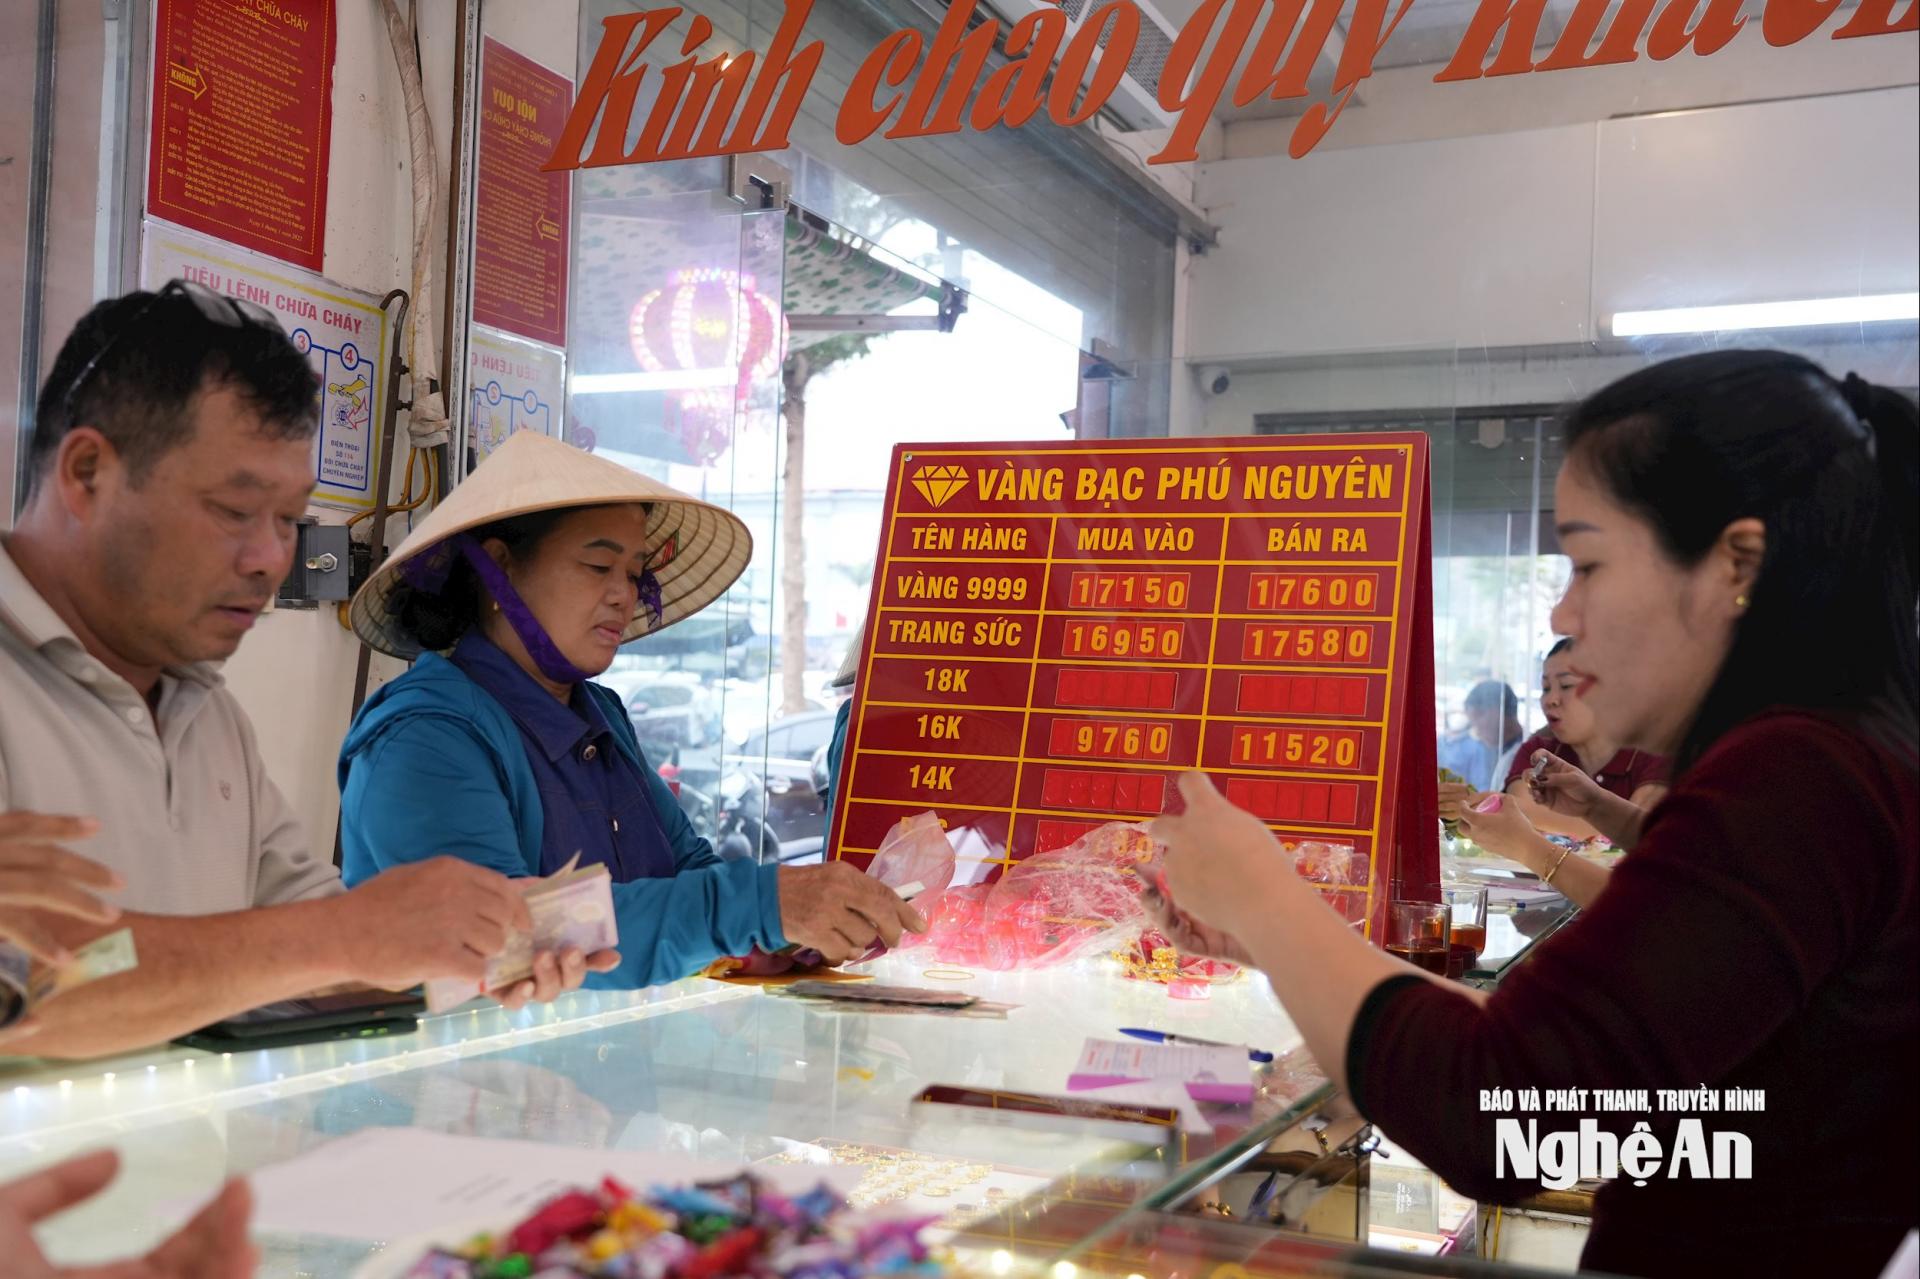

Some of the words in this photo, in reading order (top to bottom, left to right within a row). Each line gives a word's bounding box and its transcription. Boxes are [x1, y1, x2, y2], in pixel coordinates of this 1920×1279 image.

[283, 12, 308, 32] CHÁY
[323, 309, 362, 335] CHÁY
[297, 334, 306, 350] 3
[344, 349, 354, 364] 4
[978, 461, 1064, 501] VÀNG
[1076, 467, 1144, 508] BẠC
[1157, 458, 1231, 500] PHÚ
[1243, 456, 1393, 500] NGUYÊN
[912, 524, 954, 549] TÊN
[962, 528, 1027, 550] HÀNG
[1078, 528, 1133, 551] MUA
[1145, 528, 1194, 551] VÀO
[1267, 522, 1322, 552] BÁN
[1332, 528, 1368, 552] RA
[898, 576, 958, 599] VÀNG
[968, 577, 1027, 600] 9999
[1078, 578, 1184, 607] 17150
[1256, 579, 1371, 605] 17600
[889, 620, 964, 644] TRANG
[974, 617, 1022, 646] SỨC
[1072, 626, 1179, 656] 16950
[1251, 630, 1368, 656] 17580
[924, 669, 969, 691] 18K
[917, 716, 961, 739] 16K
[1078, 728, 1167, 753] 9760
[1240, 734, 1354, 766] 11520
[909, 765, 954, 790] 14K
